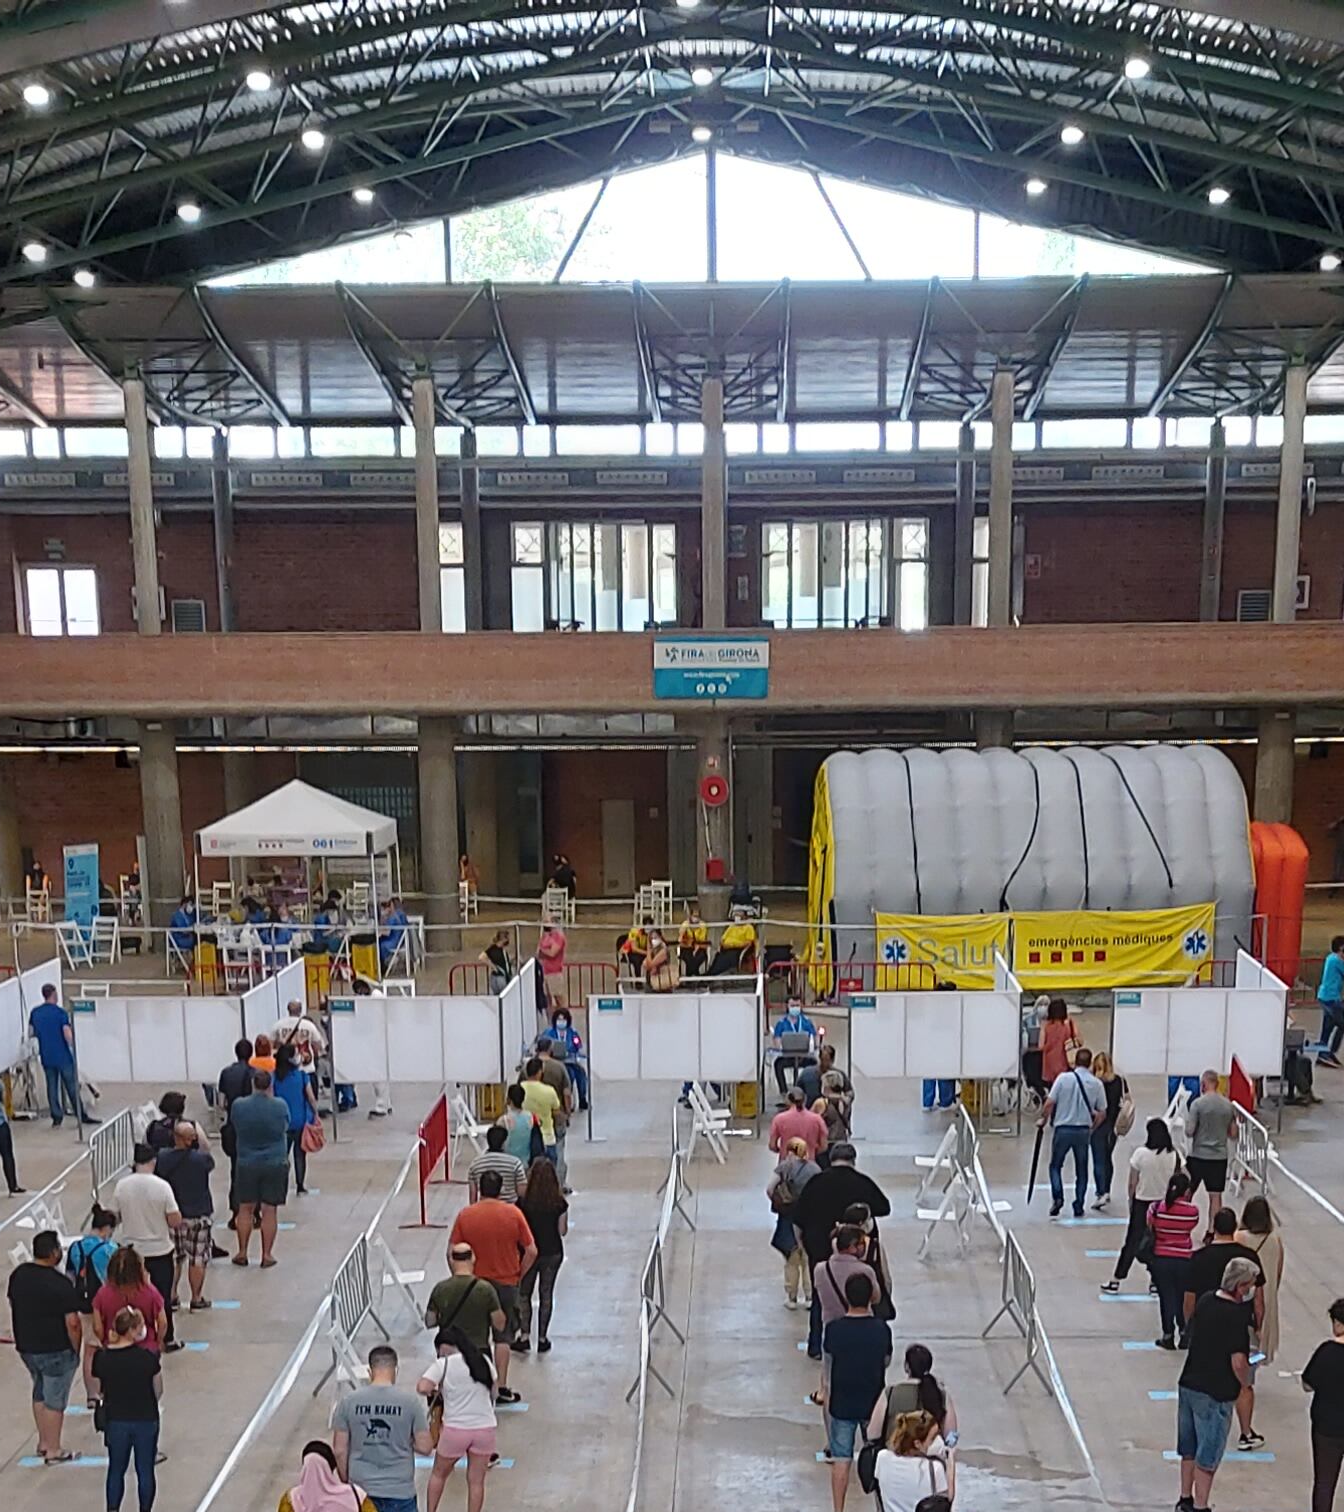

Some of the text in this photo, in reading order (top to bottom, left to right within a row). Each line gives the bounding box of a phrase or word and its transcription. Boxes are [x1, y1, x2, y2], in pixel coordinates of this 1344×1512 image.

[681, 648, 760, 658] FIRA GIRONA
[1028, 935, 1109, 948] emergències
[917, 938, 999, 966] Salut
